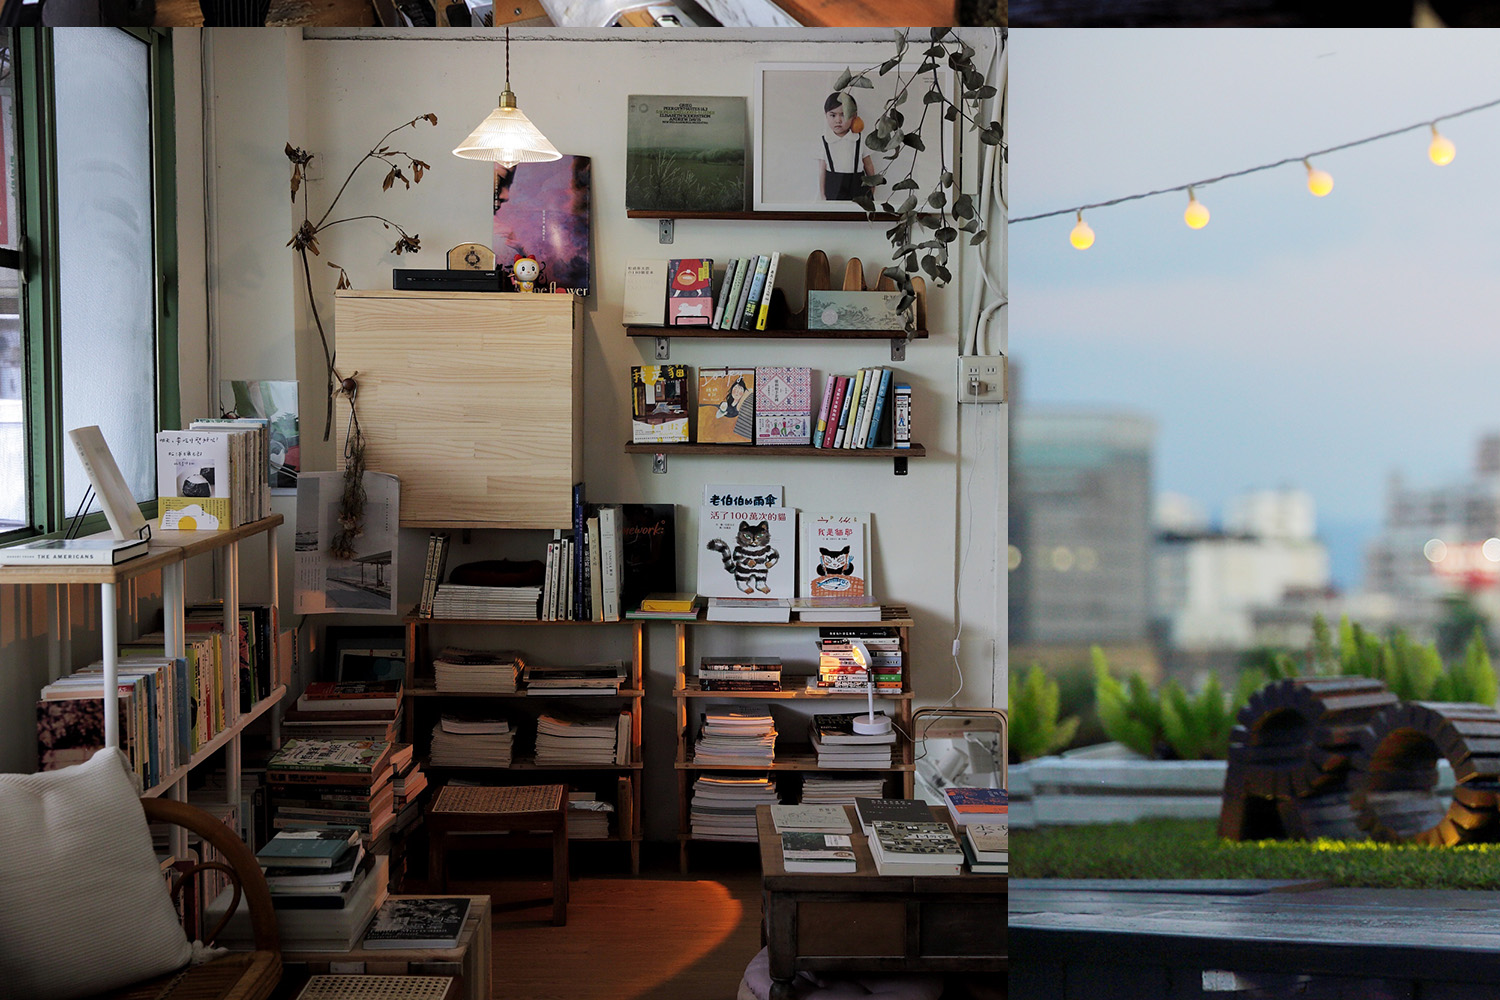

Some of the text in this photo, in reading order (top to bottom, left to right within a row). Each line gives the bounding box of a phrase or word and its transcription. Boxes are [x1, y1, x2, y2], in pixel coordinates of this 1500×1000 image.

[709, 493, 778, 508] 老伯伯的雨傘
[709, 510, 787, 522] 活了100萬次的貓
